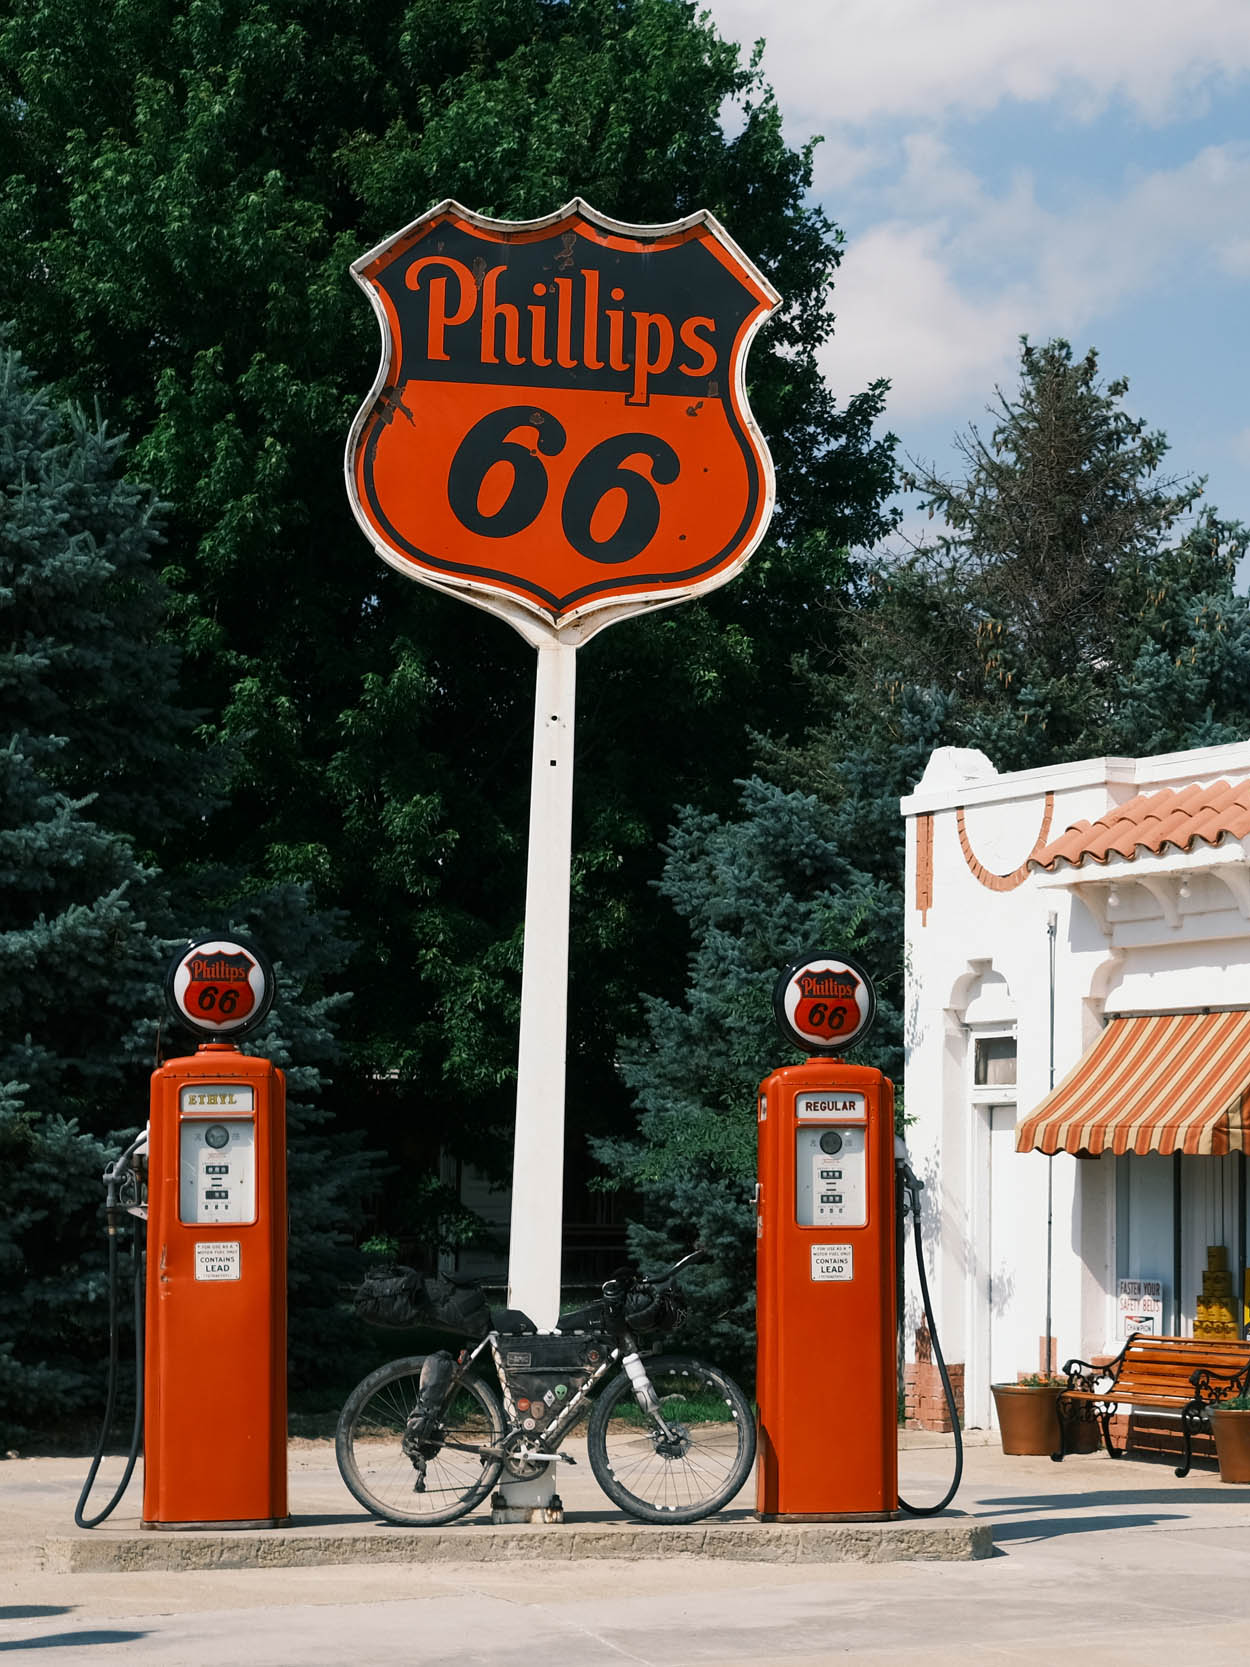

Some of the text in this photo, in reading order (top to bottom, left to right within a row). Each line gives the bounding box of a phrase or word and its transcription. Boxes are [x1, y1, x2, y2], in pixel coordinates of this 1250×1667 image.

[405, 256, 718, 405] Phillips
[447, 405, 681, 564] 66
[192, 960, 245, 983] Phillips
[801, 977, 852, 999] Phillips
[198, 986, 240, 1014] 66
[808, 1003, 848, 1030] 66
[188, 1094, 237, 1105] ETHYL
[805, 1101, 856, 1112] REGULAR
[205, 1264, 230, 1272] LEAD
[1120, 1281, 1161, 1297] FASTEN YOUR
[1120, 1297, 1160, 1312] SAFETY BELTS
[1127, 1323, 1152, 1332] CHAMPION
